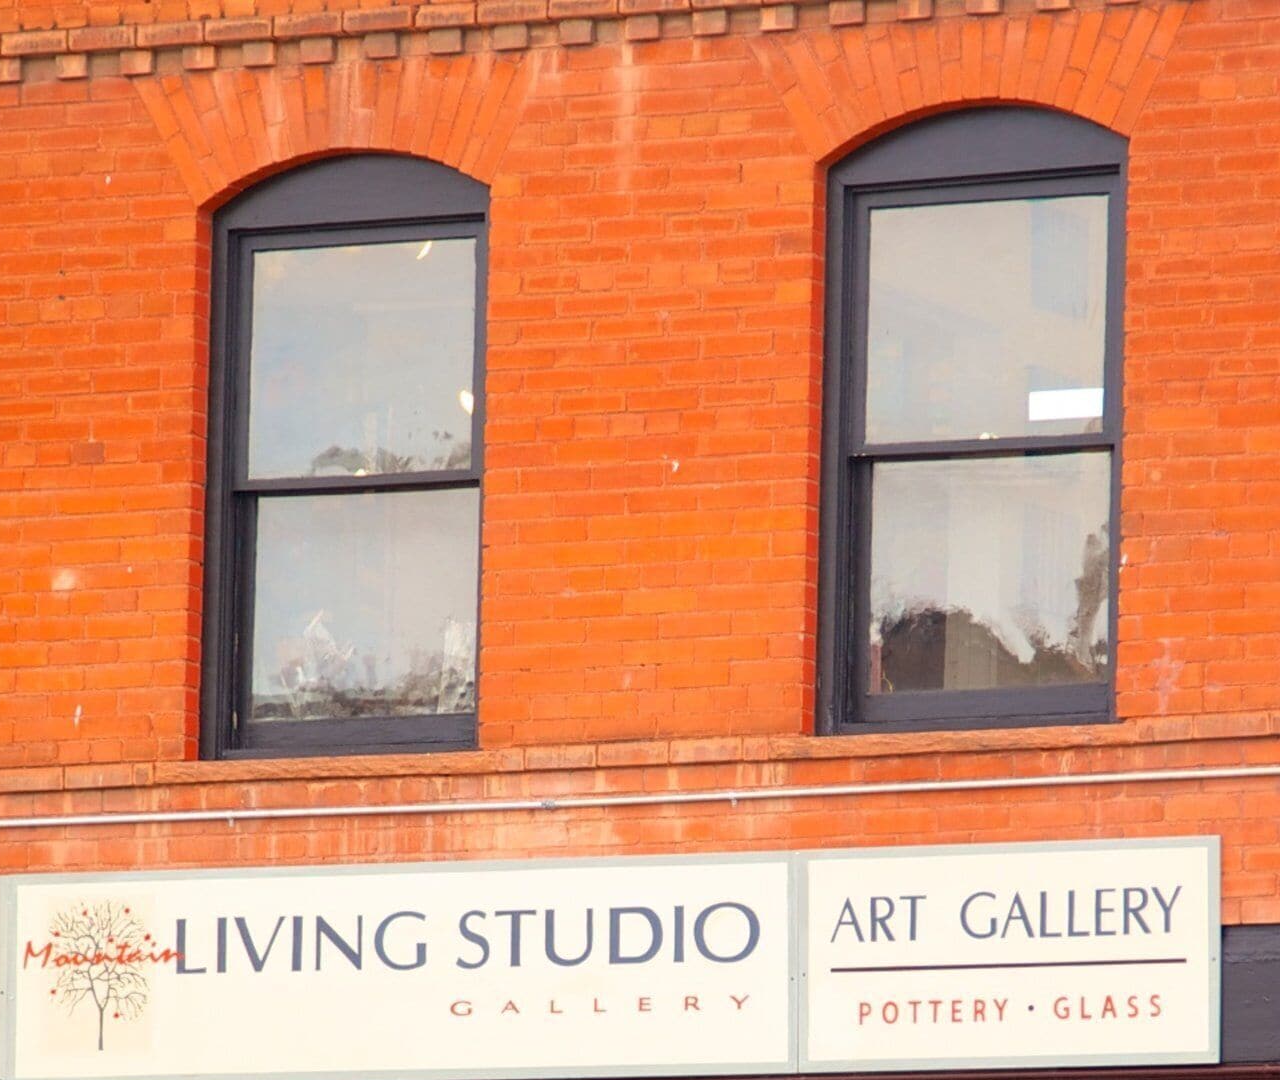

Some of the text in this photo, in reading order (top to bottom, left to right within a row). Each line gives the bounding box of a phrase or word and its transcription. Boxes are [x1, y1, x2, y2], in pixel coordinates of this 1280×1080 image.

[830, 885, 1183, 943] ART GALLERY
[22, 934, 186, 973] Mountain
[175, 901, 761, 975] LIVING STUDIO
[449, 994, 752, 1018] GALLERY
[857, 993, 1164, 1026] POTTERY GLASS
